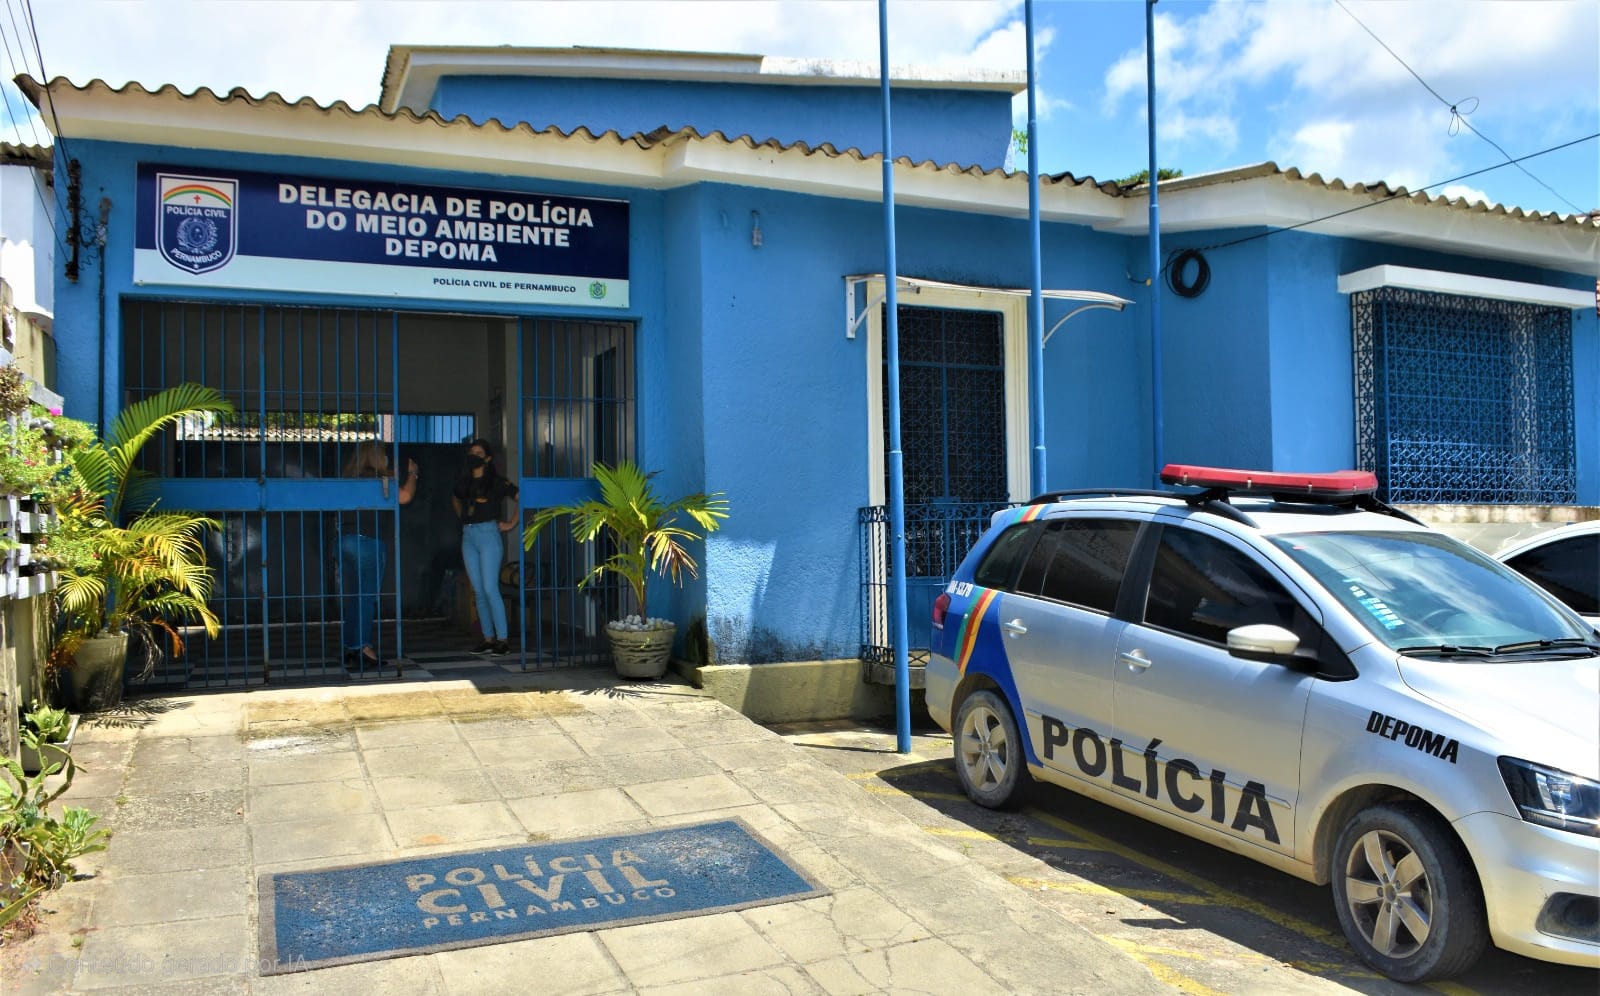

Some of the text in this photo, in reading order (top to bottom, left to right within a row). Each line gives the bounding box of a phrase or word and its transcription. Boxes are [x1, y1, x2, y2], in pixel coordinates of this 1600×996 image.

[166, 205, 227, 218] POLÍCIA CIVIL
[278, 183, 594, 227] DELEGACIA DE POLÍCIA
[306, 209, 570, 247] DO MEIO AMBIENTE
[170, 247, 222, 264] PERNAMBUCO
[385, 238, 498, 262] DEPOMA
[433, 277, 576, 293] POLÍCIA CIVIL DE PERNAMBUCO
[1365, 710, 1460, 765] DEPOMA
[1041, 714, 1281, 845] POLÍCIA
[404, 850, 648, 892] POLÍCIA
[416, 865, 671, 915] CIVIL
[421, 887, 677, 929] PERNAMBUCO
